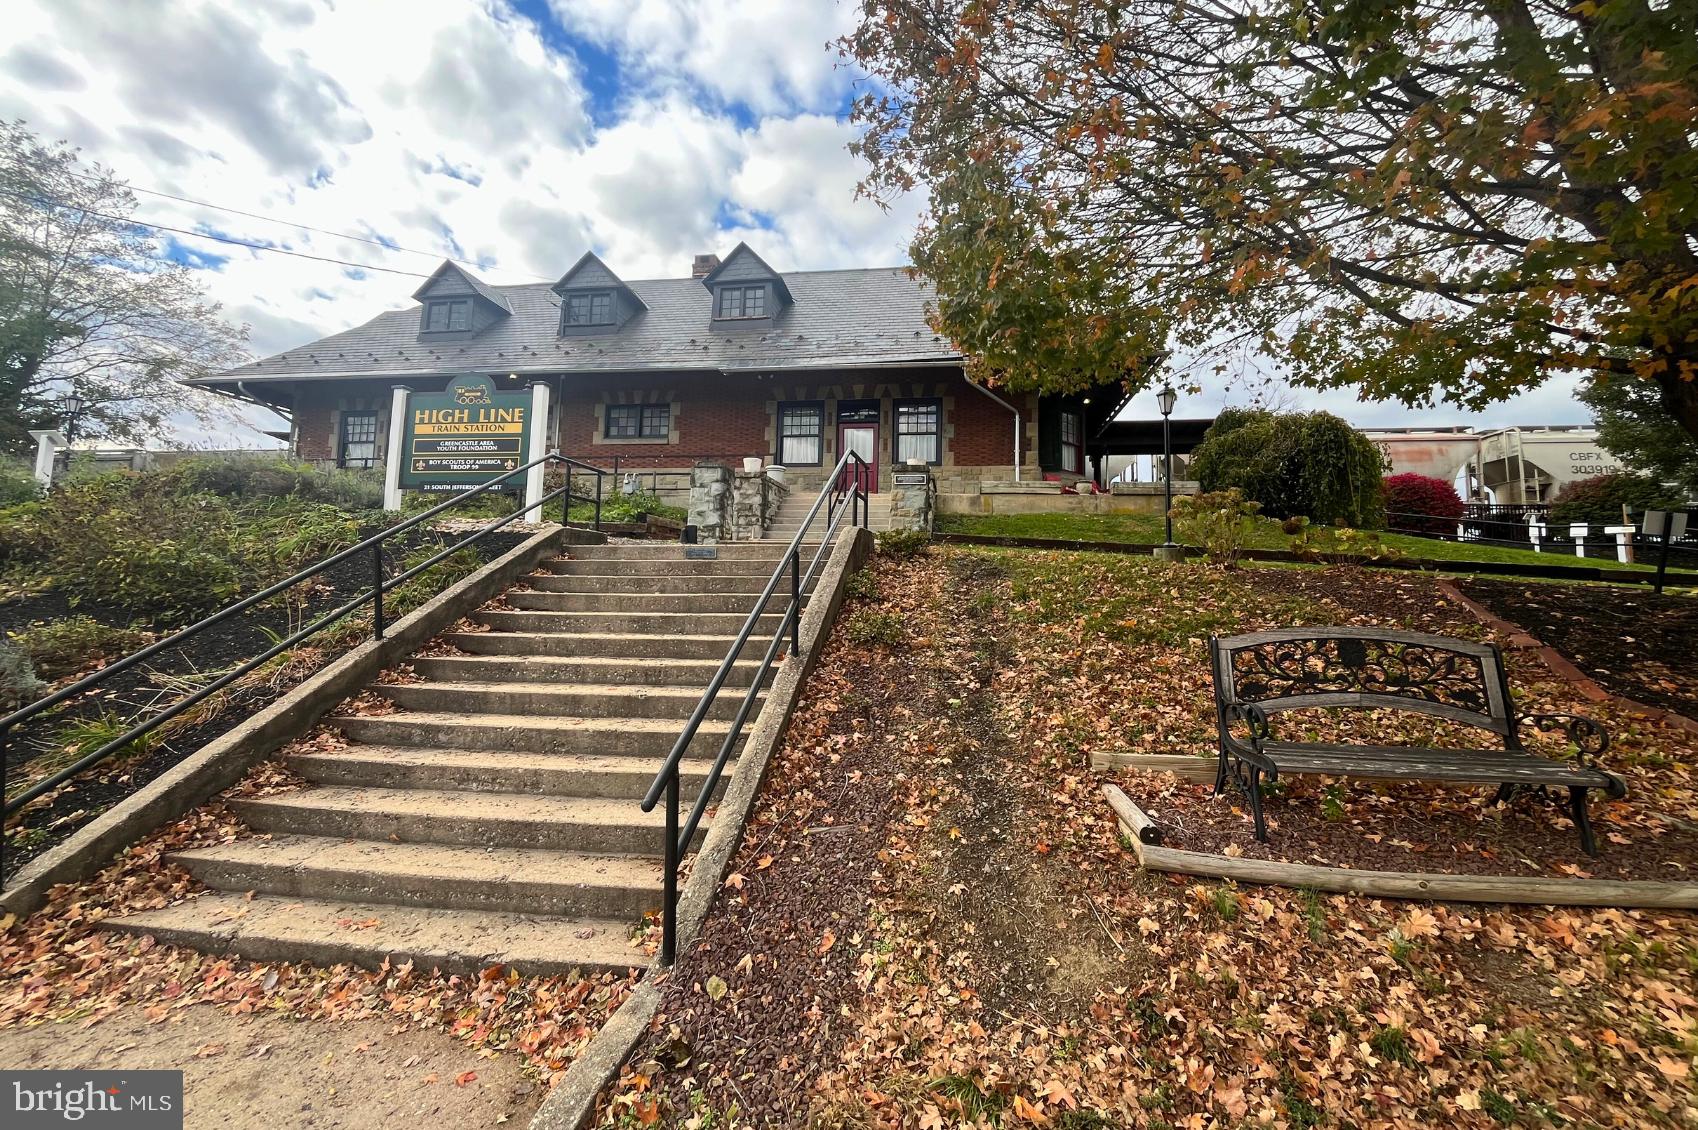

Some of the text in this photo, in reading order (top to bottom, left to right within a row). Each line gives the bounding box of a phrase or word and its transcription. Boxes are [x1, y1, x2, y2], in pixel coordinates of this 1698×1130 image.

[415, 408, 524, 423] HIGH LINE
[432, 424, 505, 433] TRAIN STATION
[1569, 452, 1603, 461] CBFX
